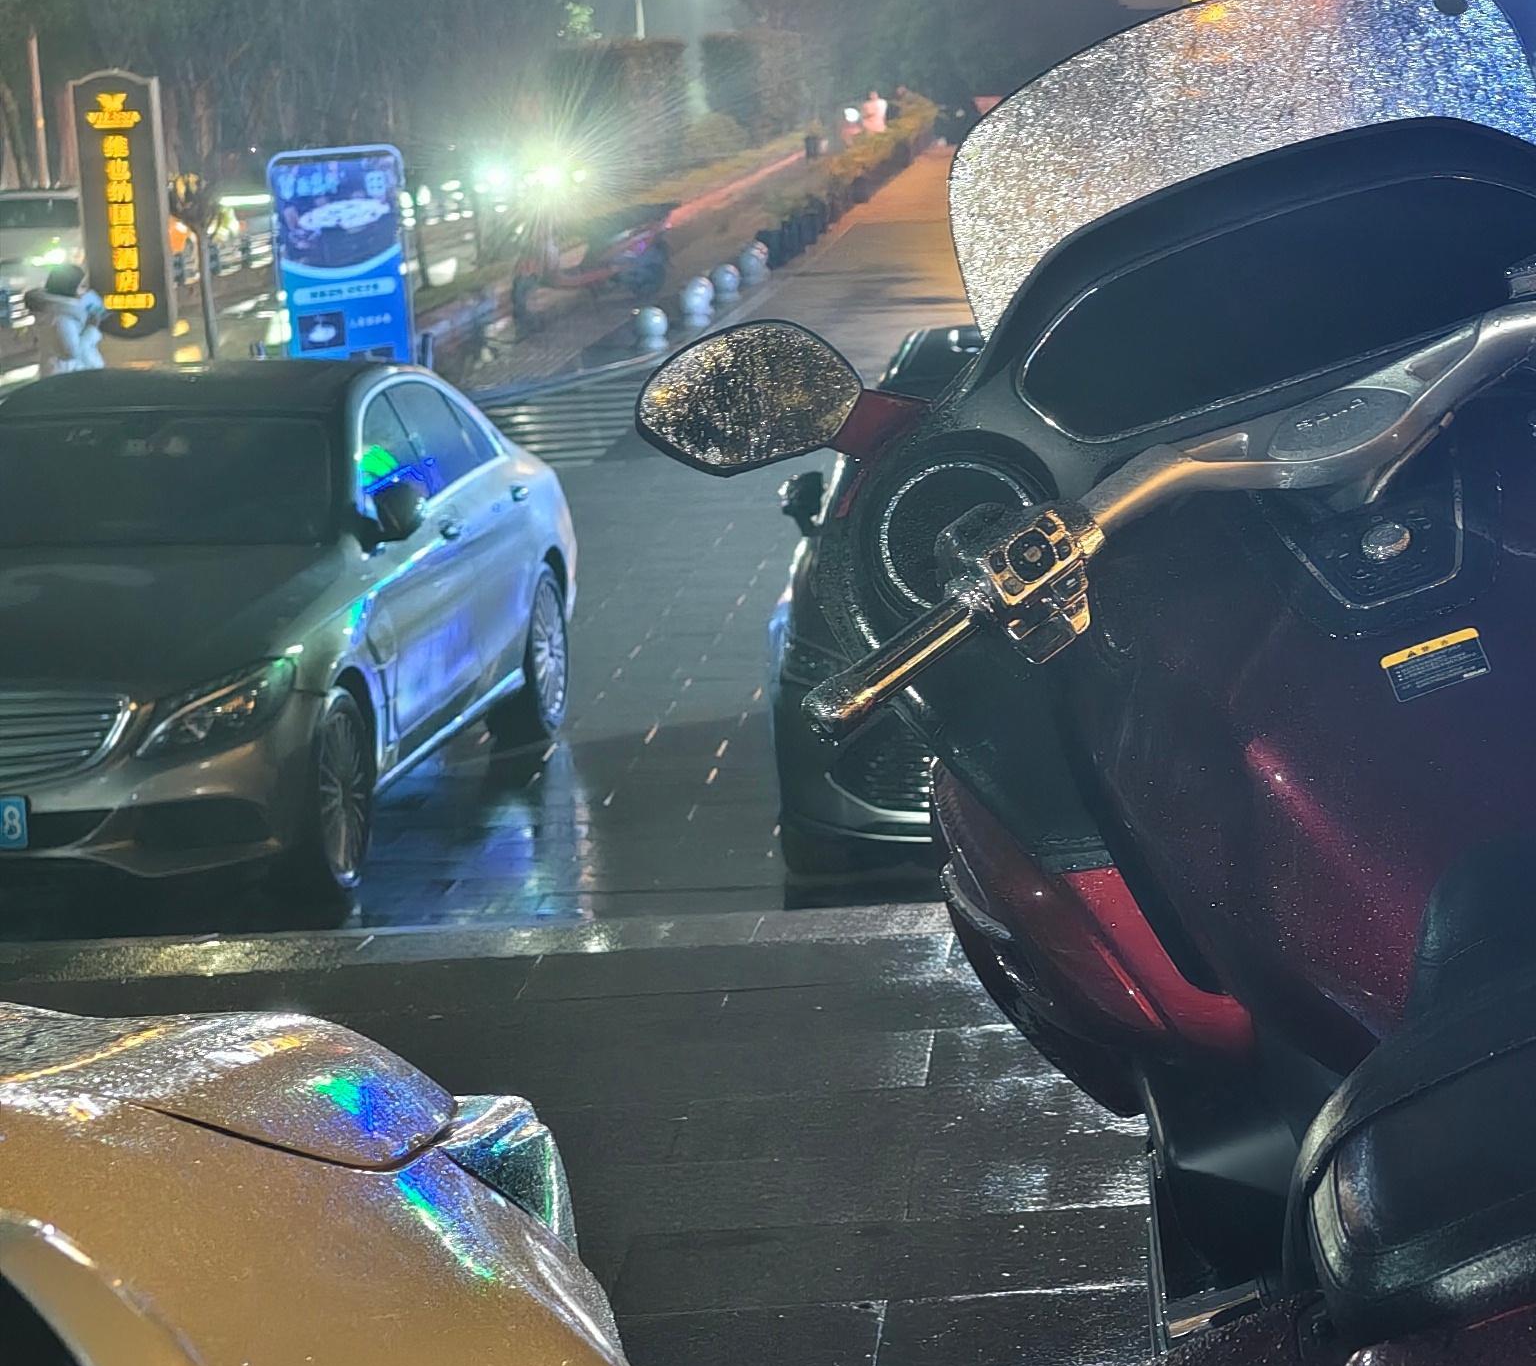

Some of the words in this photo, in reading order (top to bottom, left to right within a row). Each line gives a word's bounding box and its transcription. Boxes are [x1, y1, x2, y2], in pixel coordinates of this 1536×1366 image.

[103, 135, 139, 292] 维也纳国际酒店
